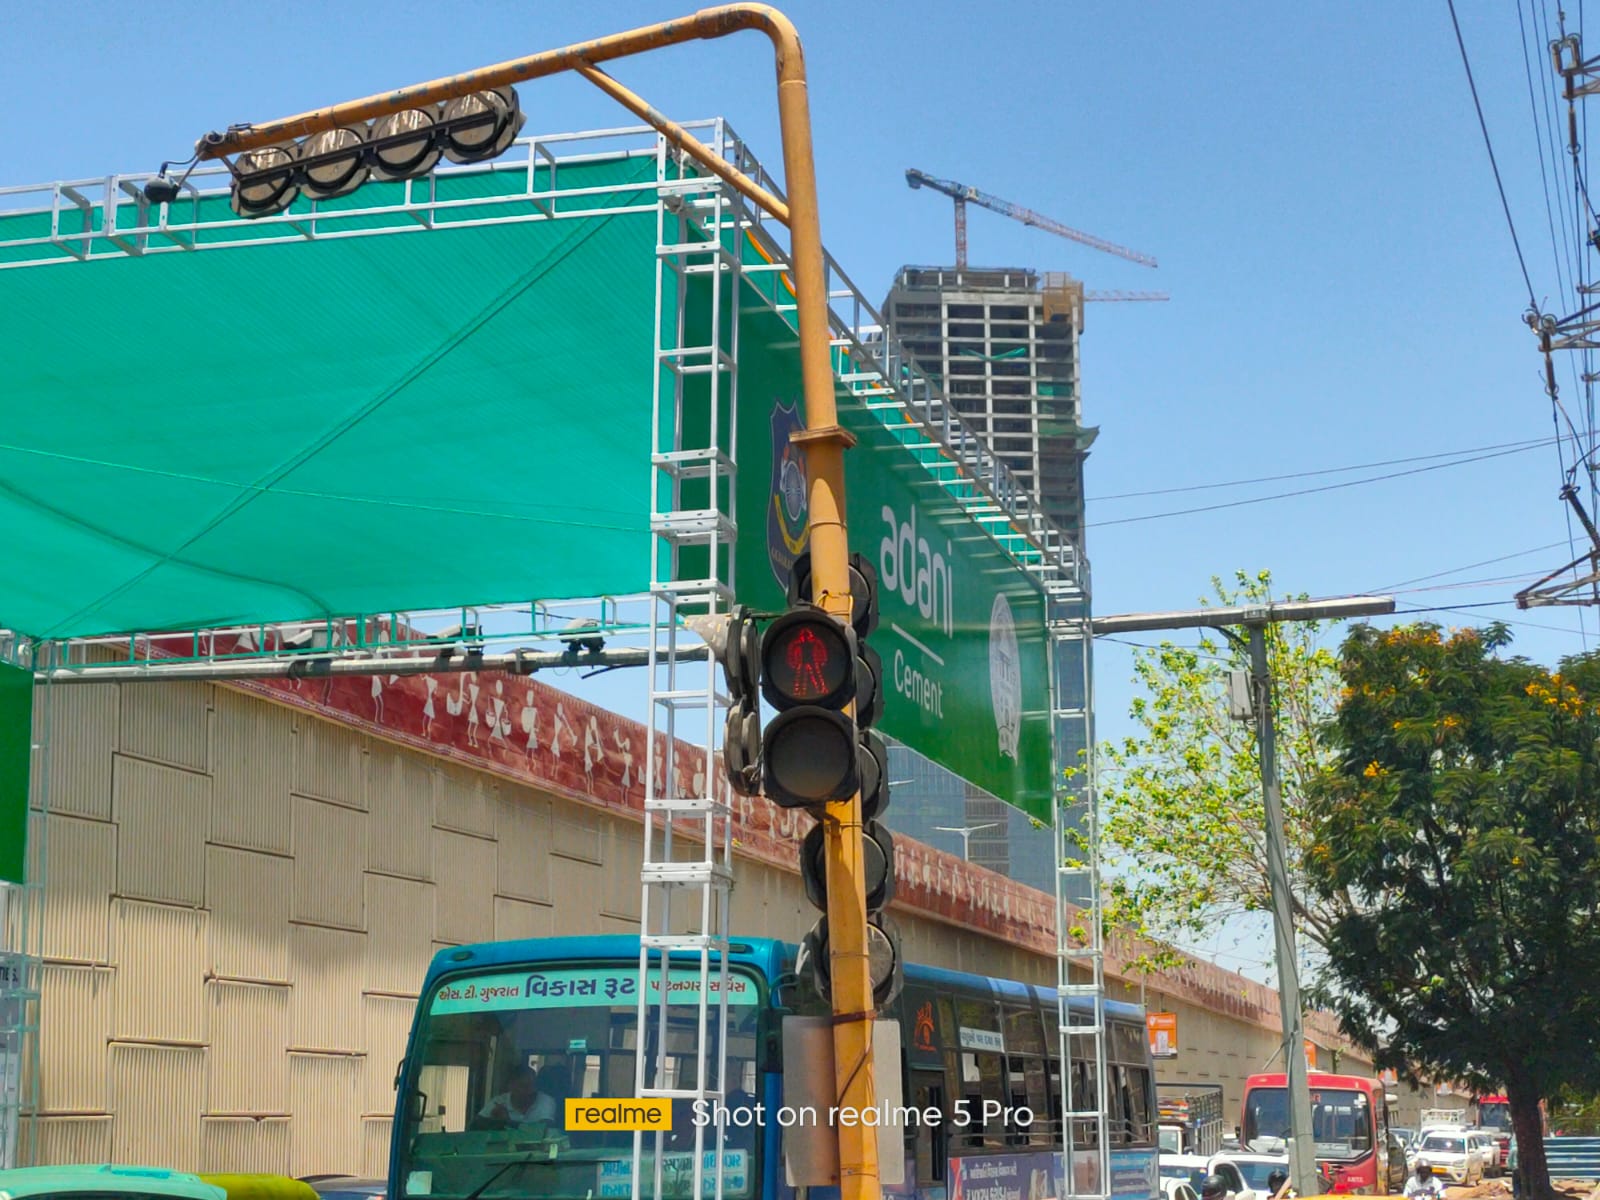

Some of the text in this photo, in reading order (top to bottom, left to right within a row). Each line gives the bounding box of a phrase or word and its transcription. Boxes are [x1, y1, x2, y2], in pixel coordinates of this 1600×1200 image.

[880, 504, 953, 639] adani
[894, 649, 943, 719] Cement
[480, 986, 519, 1002] ગુજરાત
[524, 974, 597, 998] વિકાસ
[604, 977, 635, 1000] રૂટ
[651, 980, 702, 992] પટનગર
